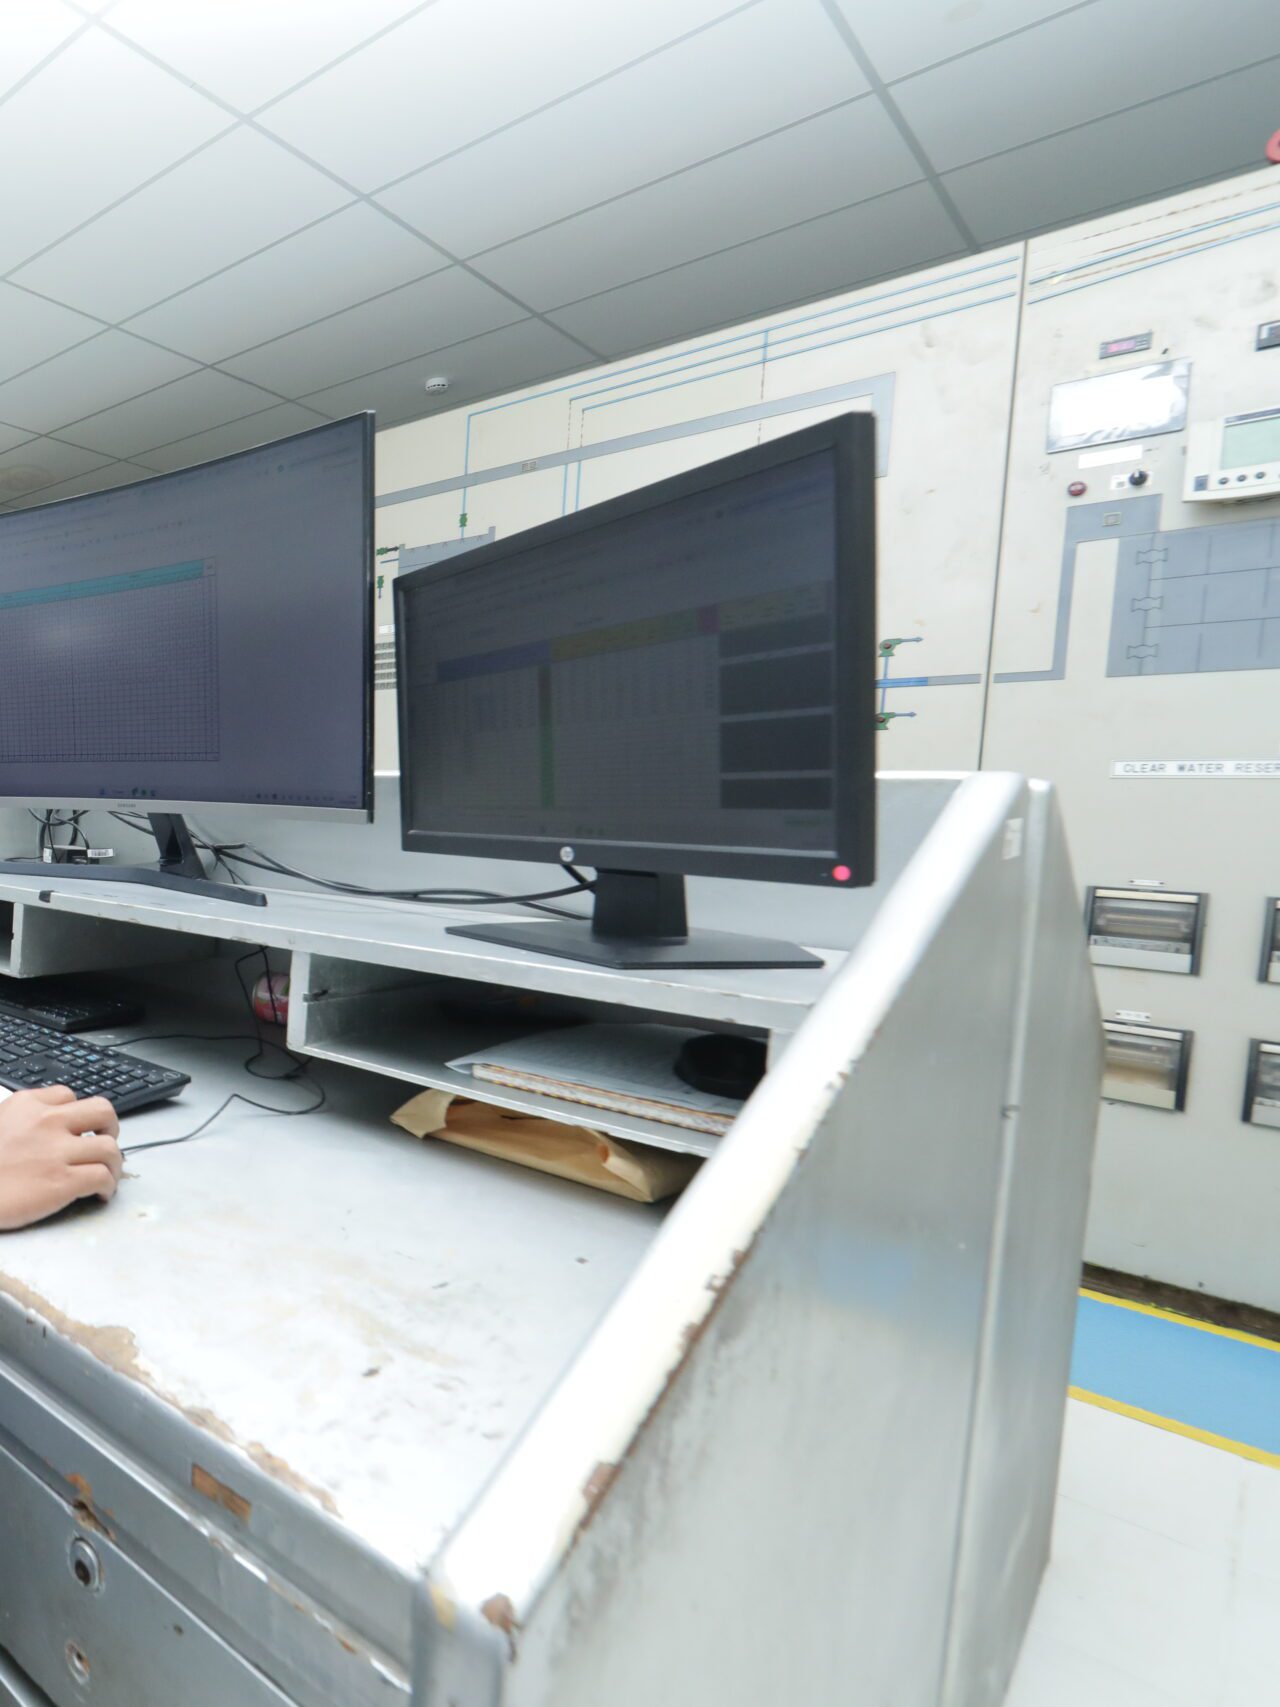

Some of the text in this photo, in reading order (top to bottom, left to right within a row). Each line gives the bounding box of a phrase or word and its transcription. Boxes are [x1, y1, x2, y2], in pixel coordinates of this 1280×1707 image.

[1122, 763, 1280, 774] CLEAR WATER RESER
